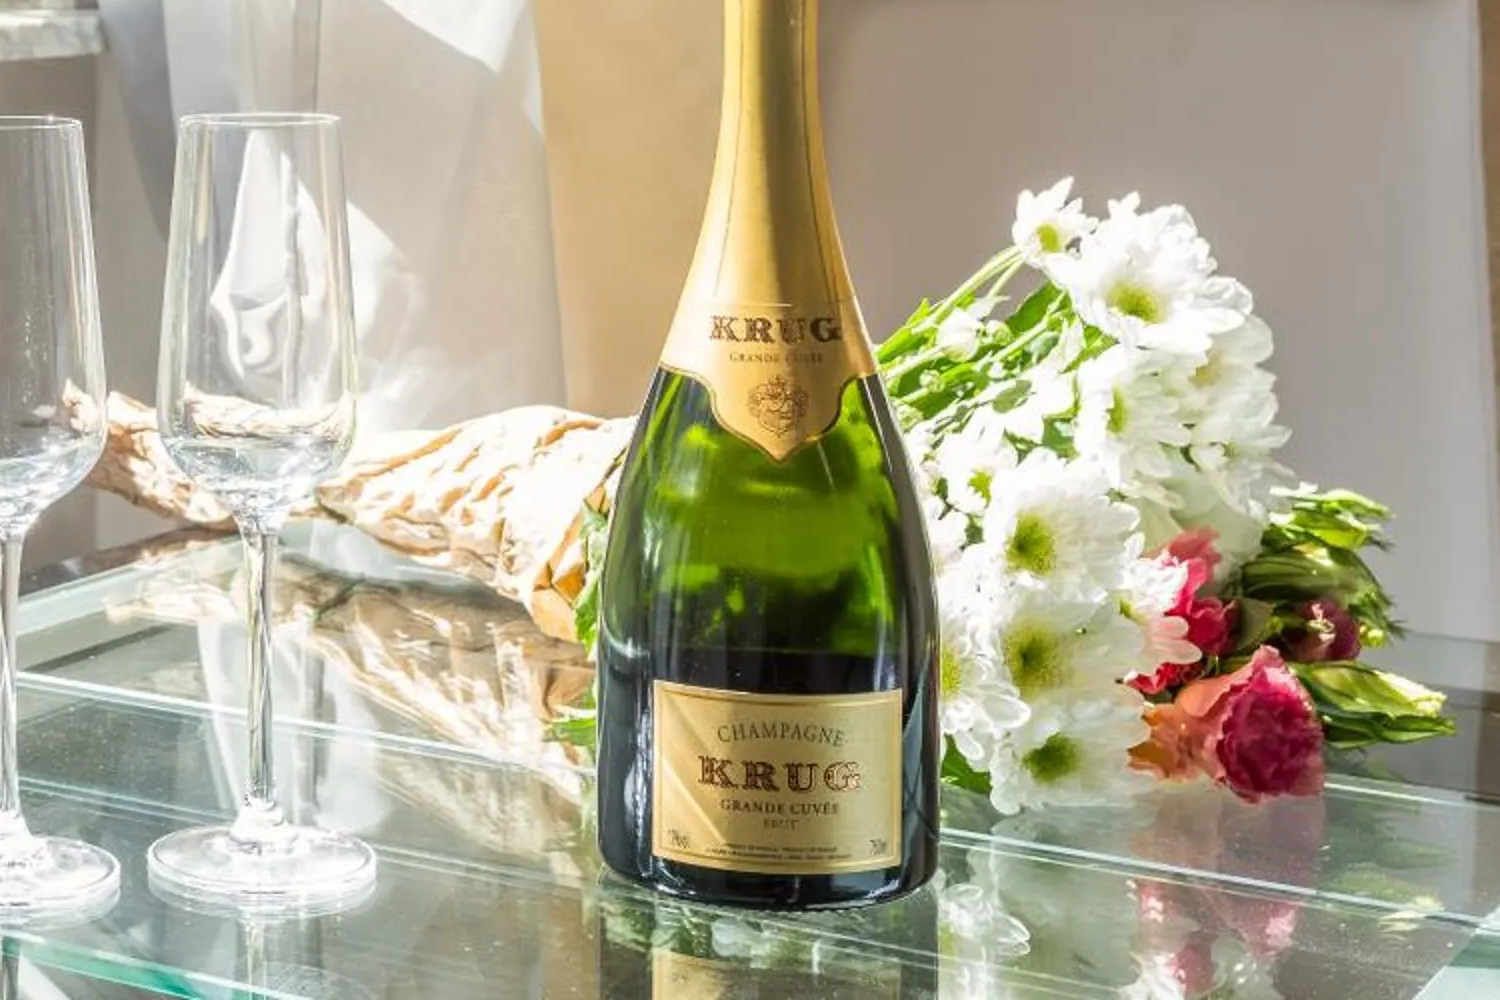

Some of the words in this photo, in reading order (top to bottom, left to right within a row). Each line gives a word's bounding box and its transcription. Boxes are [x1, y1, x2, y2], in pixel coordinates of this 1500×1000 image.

[709, 315, 842, 343] KRUG
[717, 721, 846, 747] CHAMPAGNE
[697, 755, 861, 793] KRUG
[721, 799, 785, 814] GRANDE
